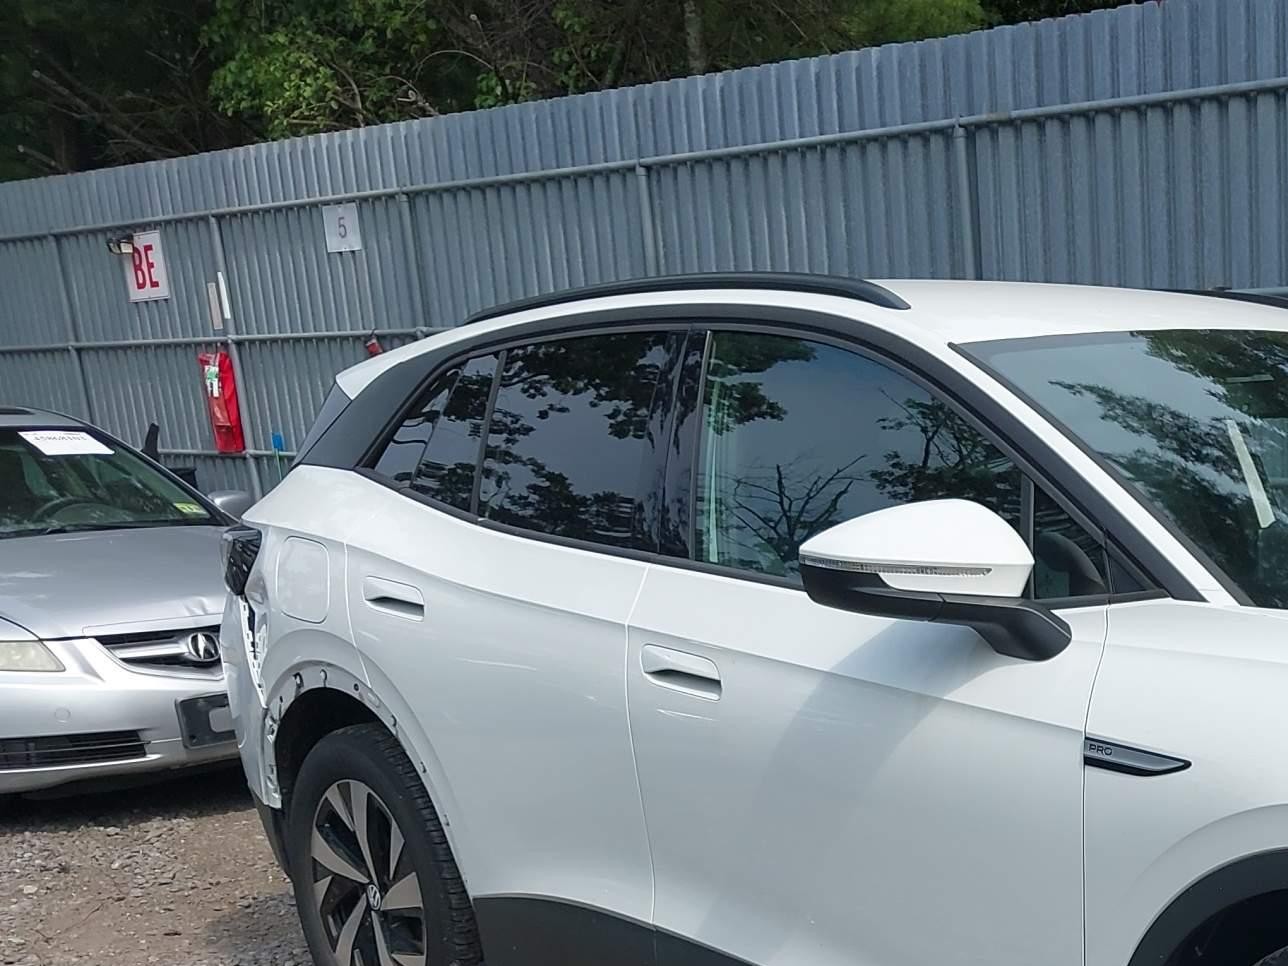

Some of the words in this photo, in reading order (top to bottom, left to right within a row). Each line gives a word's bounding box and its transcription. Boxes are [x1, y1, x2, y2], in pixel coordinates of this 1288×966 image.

[337, 216, 347, 239] 5
[132, 244, 160, 290] BE
[1088, 743, 1113, 756] PRO
